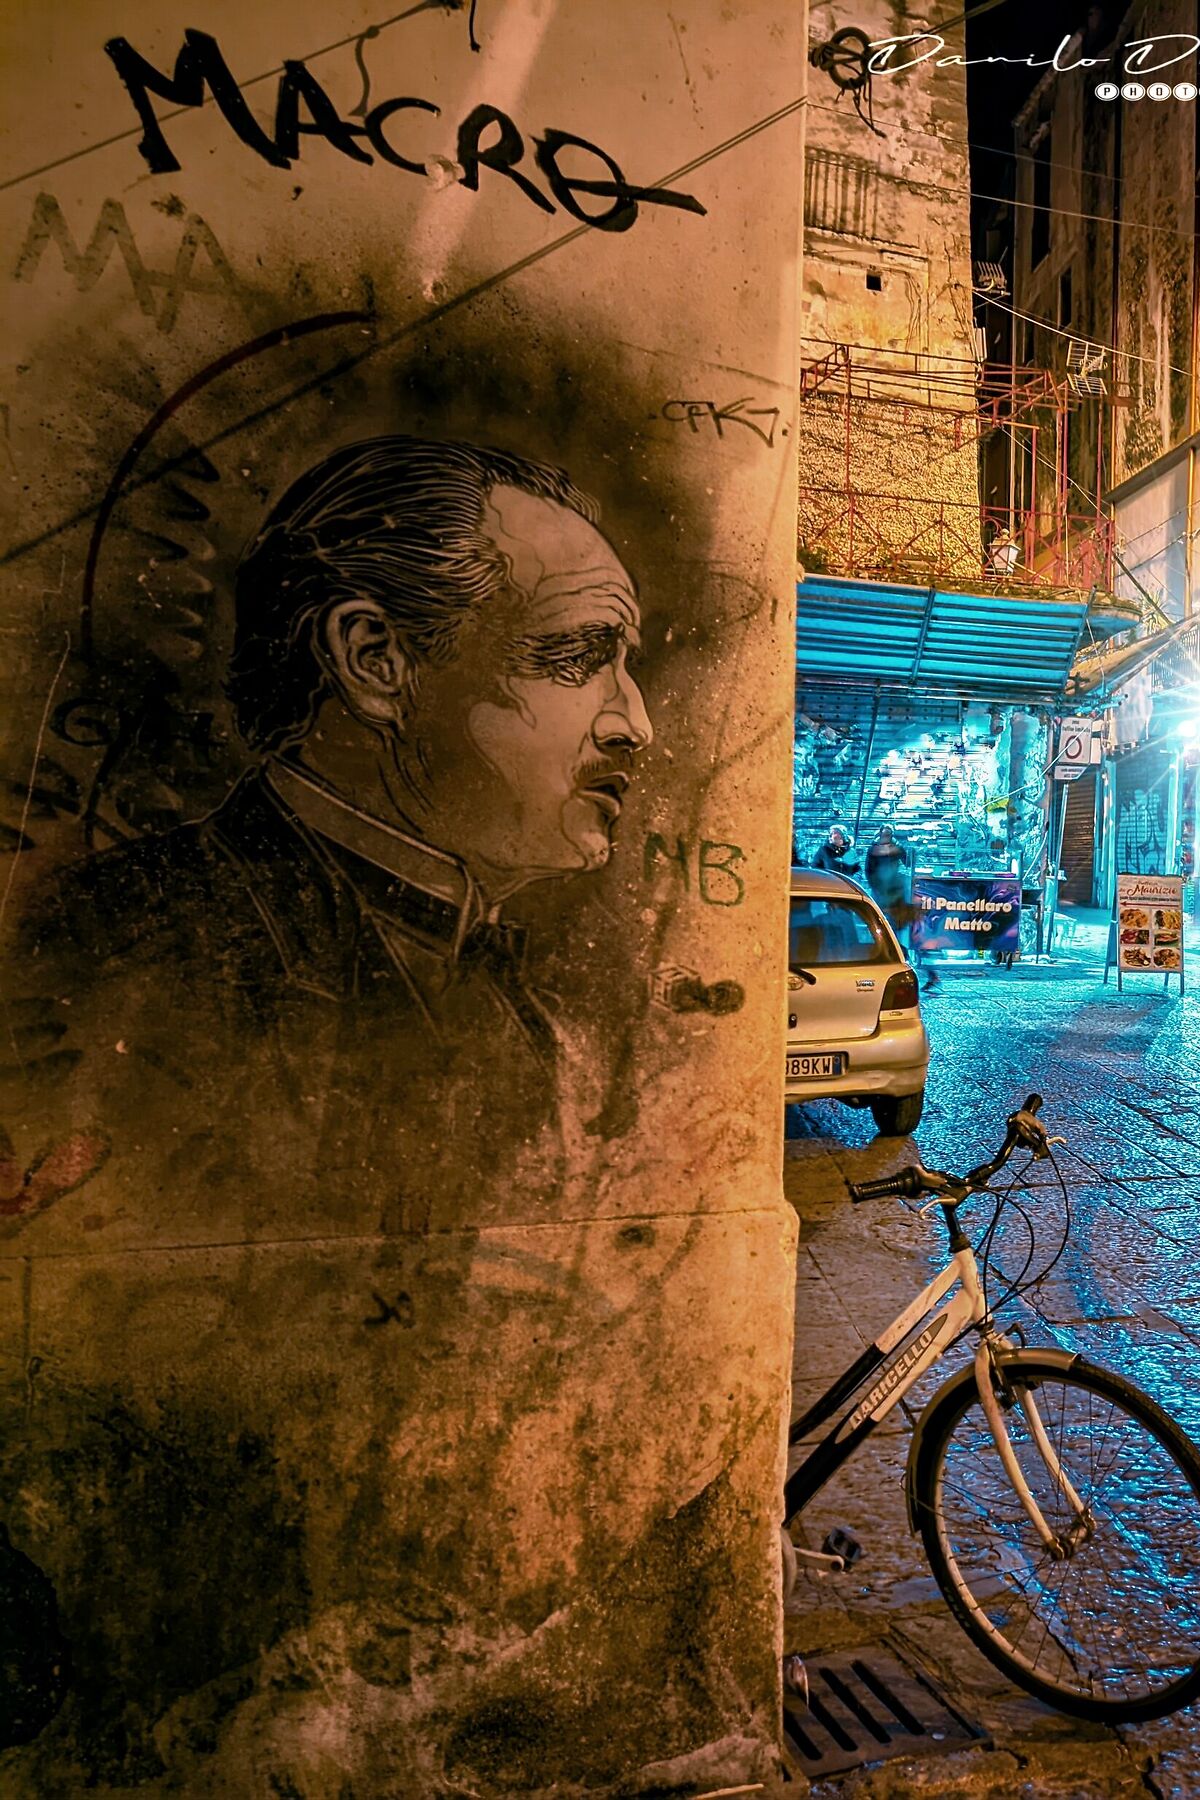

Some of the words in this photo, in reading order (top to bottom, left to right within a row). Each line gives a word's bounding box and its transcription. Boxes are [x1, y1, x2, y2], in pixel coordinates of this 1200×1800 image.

[104, 28, 707, 233] MACRO
[1127, 884, 1177, 896] Maurizio
[935, 897, 1012, 913] Panellaro
[944, 917, 992, 931] Matto
